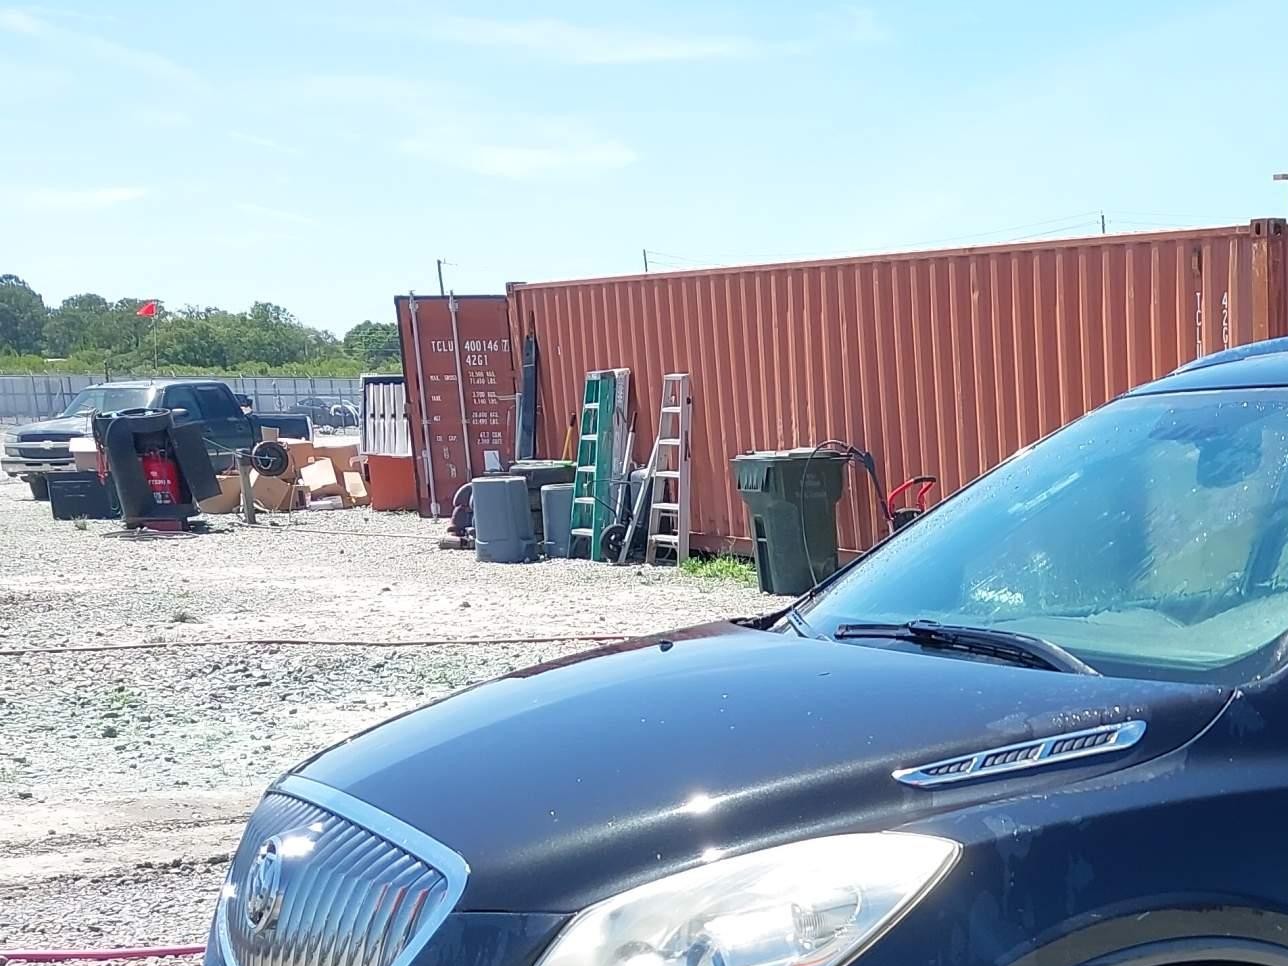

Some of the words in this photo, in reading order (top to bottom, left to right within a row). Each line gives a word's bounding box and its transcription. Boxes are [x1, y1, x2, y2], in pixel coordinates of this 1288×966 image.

[431, 340, 454, 353] TCLU
[464, 340, 499, 352] 400146
[465, 354, 489, 366] 42G1
